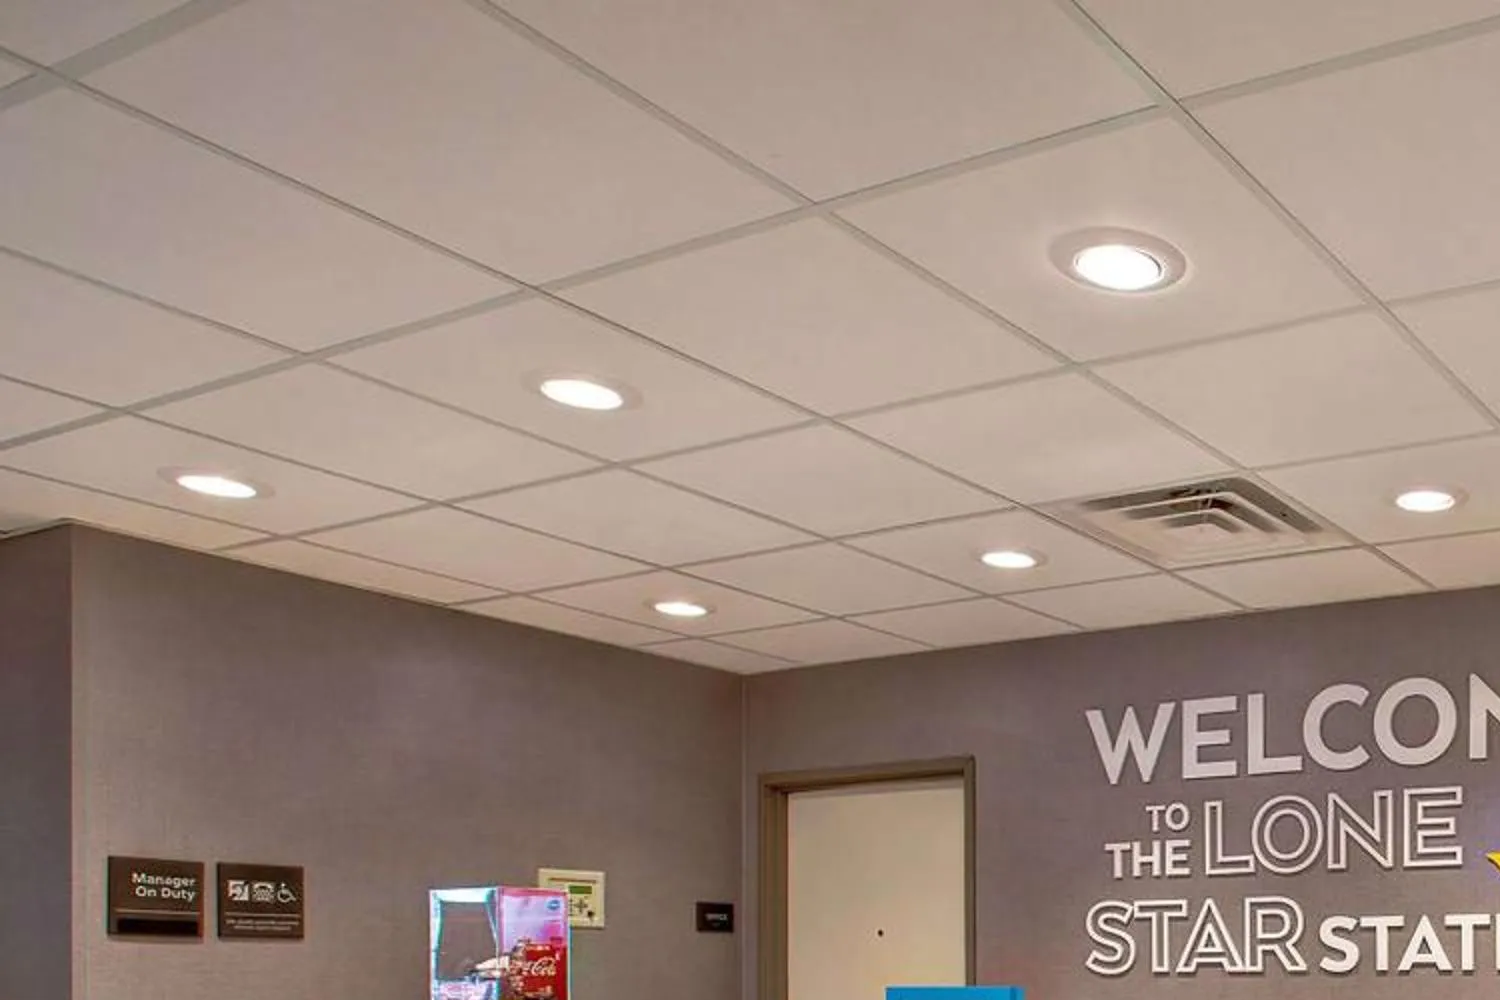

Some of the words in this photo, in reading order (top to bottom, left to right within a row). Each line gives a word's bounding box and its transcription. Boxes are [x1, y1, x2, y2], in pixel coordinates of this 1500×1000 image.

[1104, 840, 1192, 880] THE
[1204, 786, 1463, 877] LONE
[1145, 803, 1190, 833] TO
[131, 872, 196, 887] Manager
[135, 885, 157, 898] On
[161, 886, 196, 902] Duty
[1085, 896, 1309, 976] STAR
